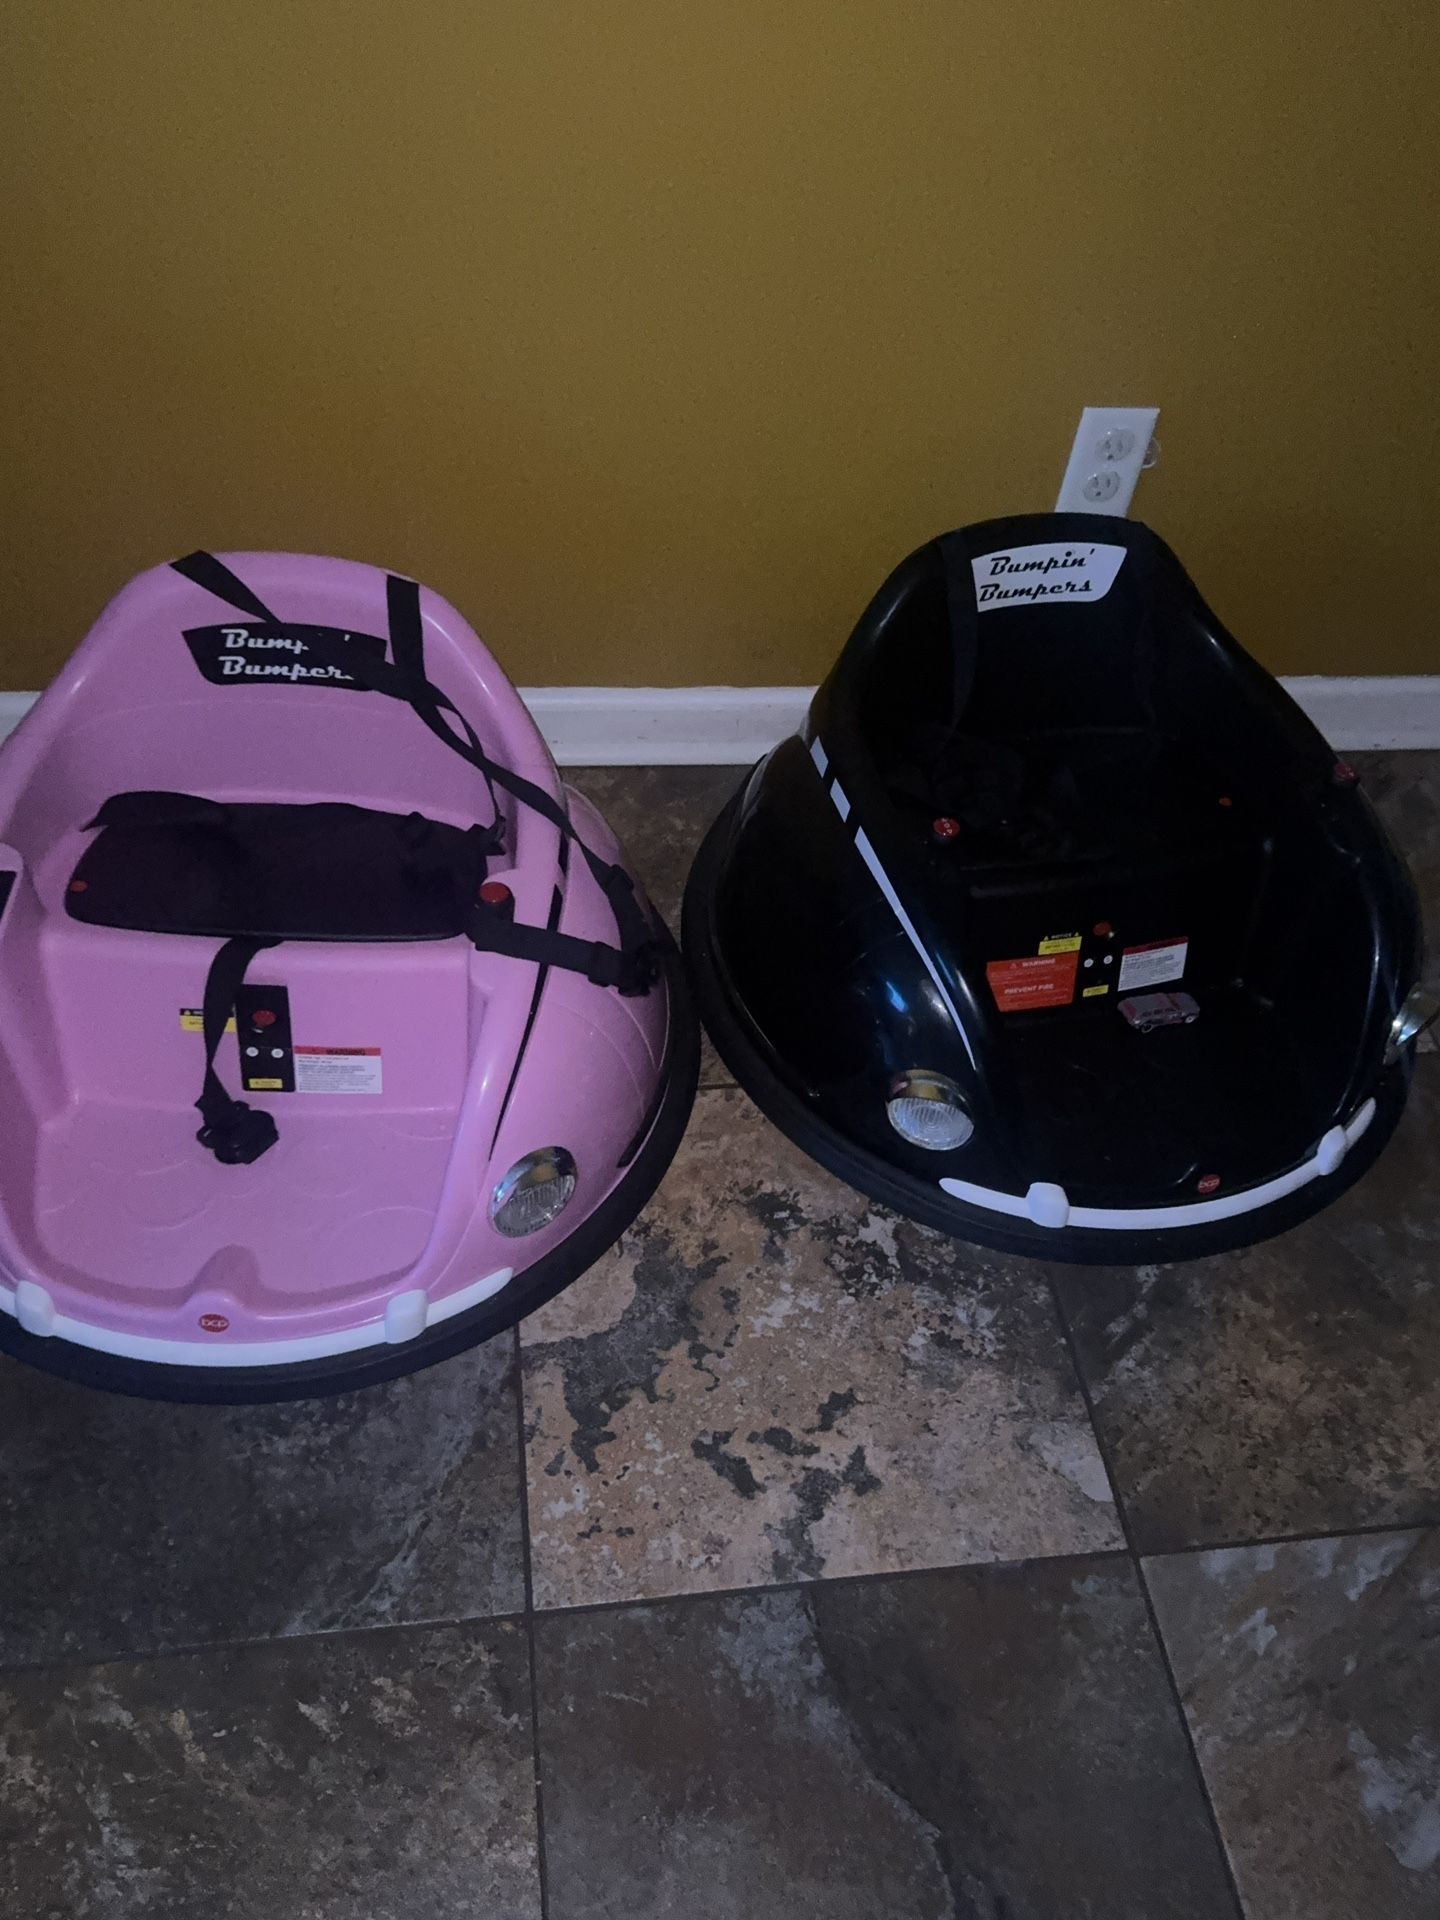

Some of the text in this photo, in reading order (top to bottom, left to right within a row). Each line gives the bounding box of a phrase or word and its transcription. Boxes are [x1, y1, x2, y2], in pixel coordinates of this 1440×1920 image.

[990, 549, 1096, 576] Bumpin'
[979, 579, 1093, 602] Bumpers
[218, 656, 354, 680] Bumper
[1003, 983, 1054, 995] PREVENT FIRE
[325, 1048, 366, 1056] WARNING
[201, 1318, 228, 1328] bcp
